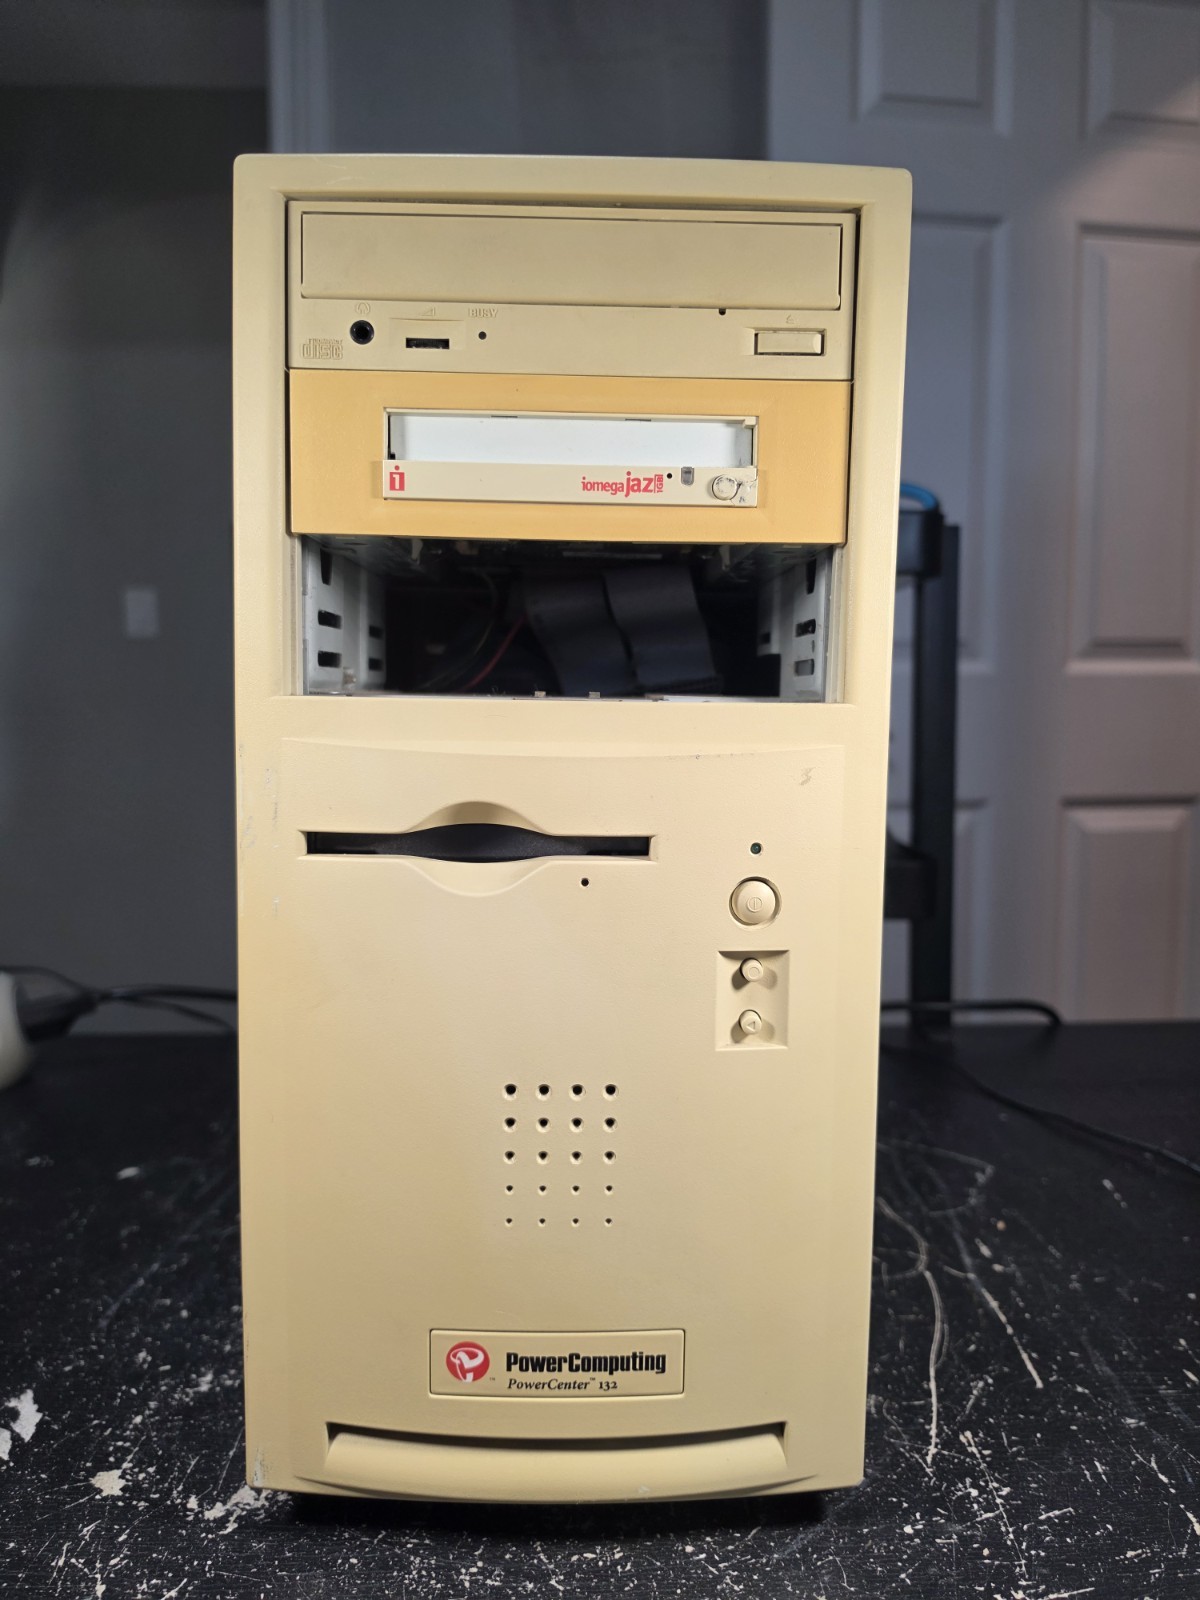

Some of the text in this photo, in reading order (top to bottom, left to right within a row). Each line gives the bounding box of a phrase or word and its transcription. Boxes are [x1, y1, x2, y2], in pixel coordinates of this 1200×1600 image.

[469, 308, 499, 318] BUSY
[581, 471, 654, 497] iomega jaz
[506, 1351, 667, 1375] PowerComputing
[599, 1381, 618, 1391] 132
